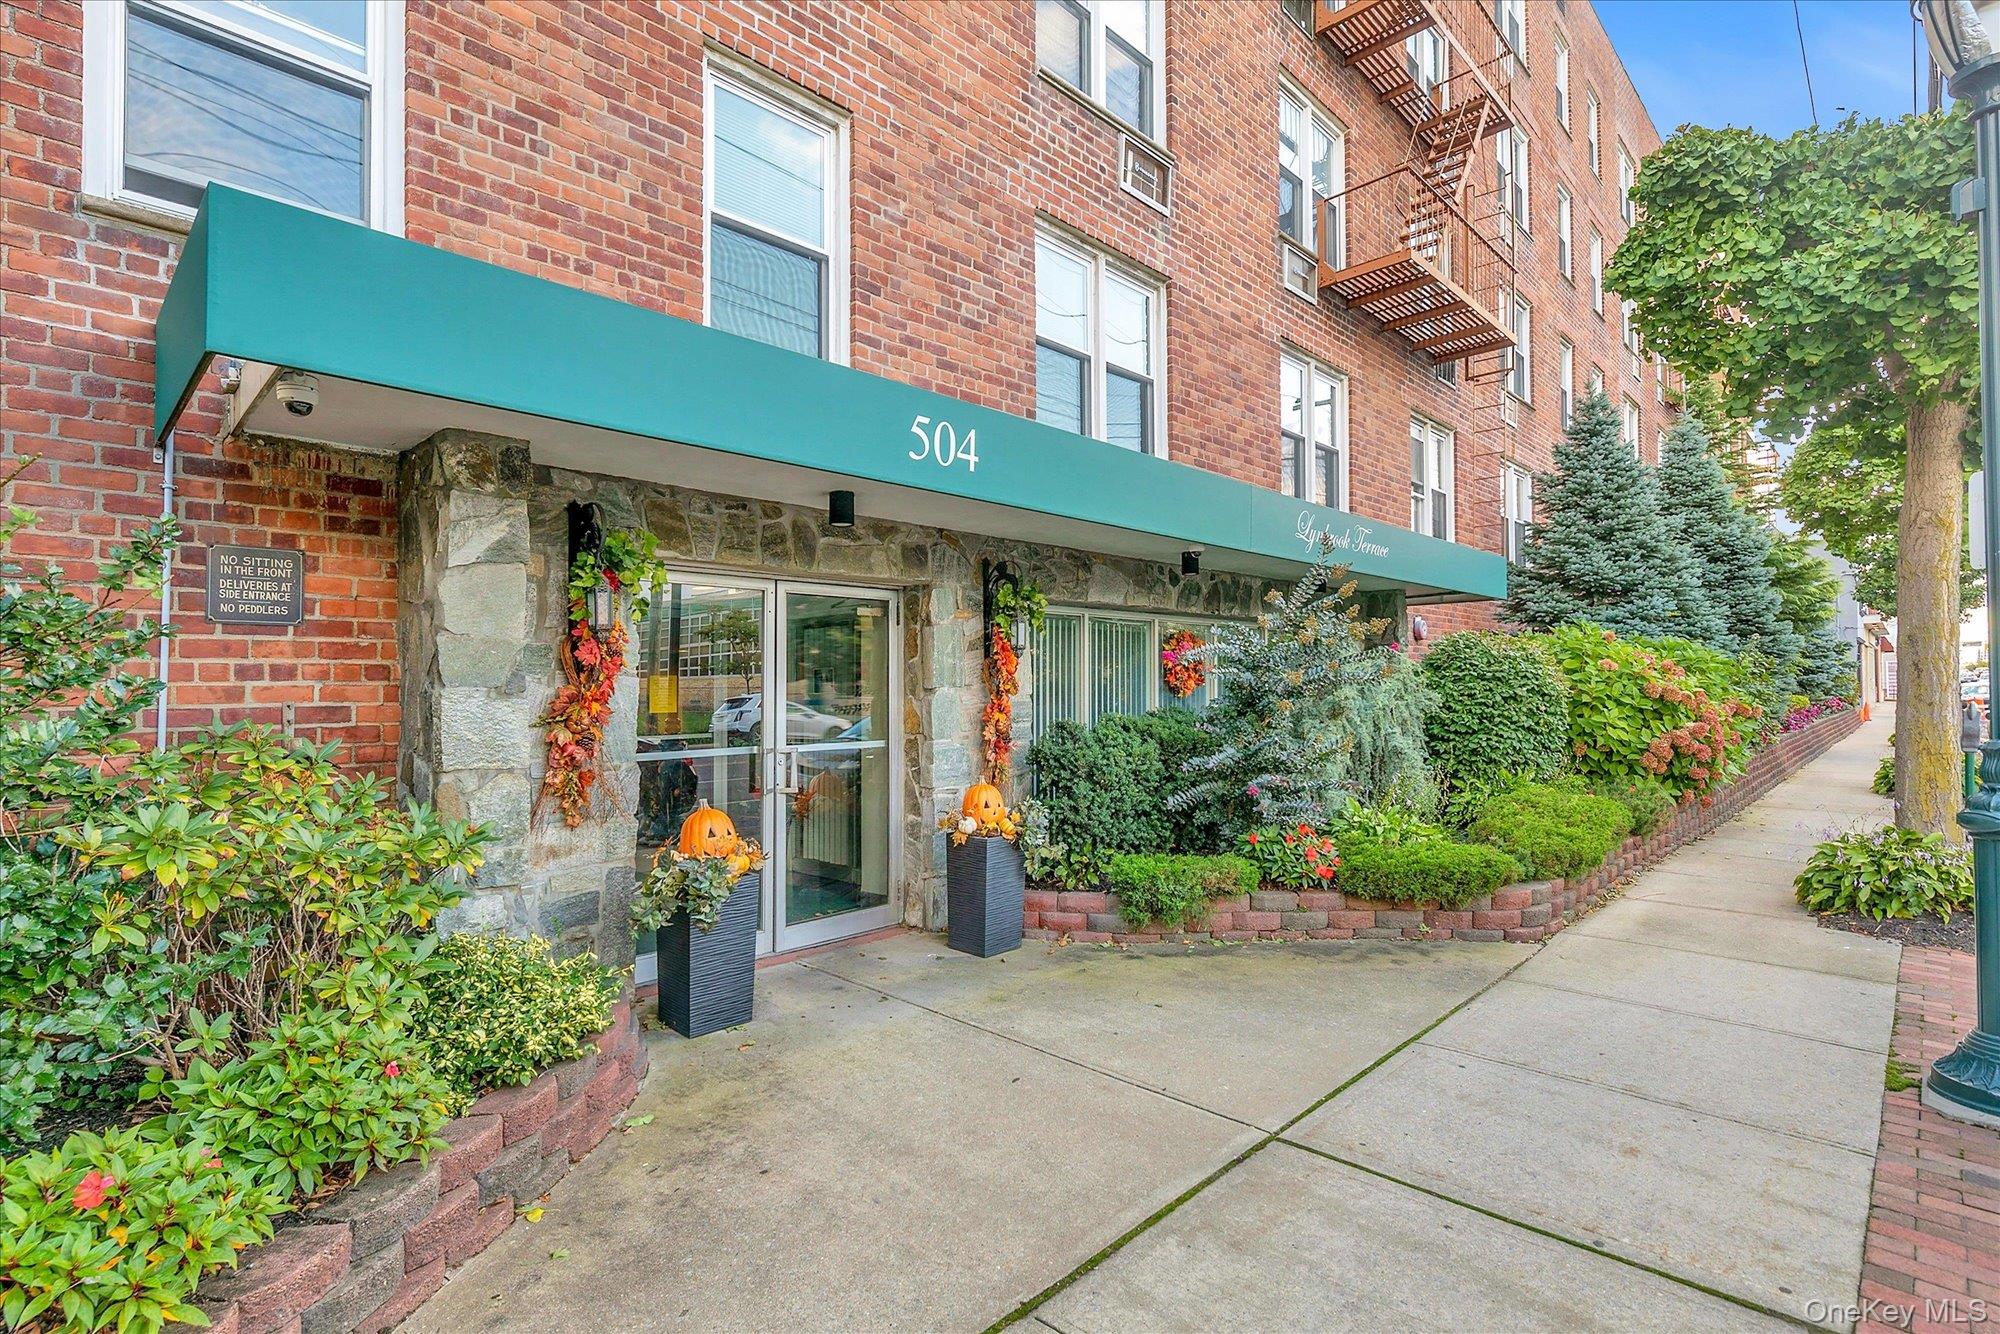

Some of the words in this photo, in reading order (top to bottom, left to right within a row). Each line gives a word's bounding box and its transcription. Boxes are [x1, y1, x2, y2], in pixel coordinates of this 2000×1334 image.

[908, 414, 979, 472] 504
[1352, 524, 1390, 558] Terrace
[220, 554, 238, 565] NO
[242, 556, 293, 569] SITTING
[220, 565, 232, 575] IN
[235, 565, 254, 576] THE
[257, 567, 293, 579] FRONT
[219, 578, 279, 592] DELIVERIES
[281, 582, 293, 593] AT
[219, 589, 240, 599] SIDE
[242, 590, 291, 602] ENTRANCE
[220, 603, 235, 613] NO
[238, 604, 289, 615] PEDDLERS
